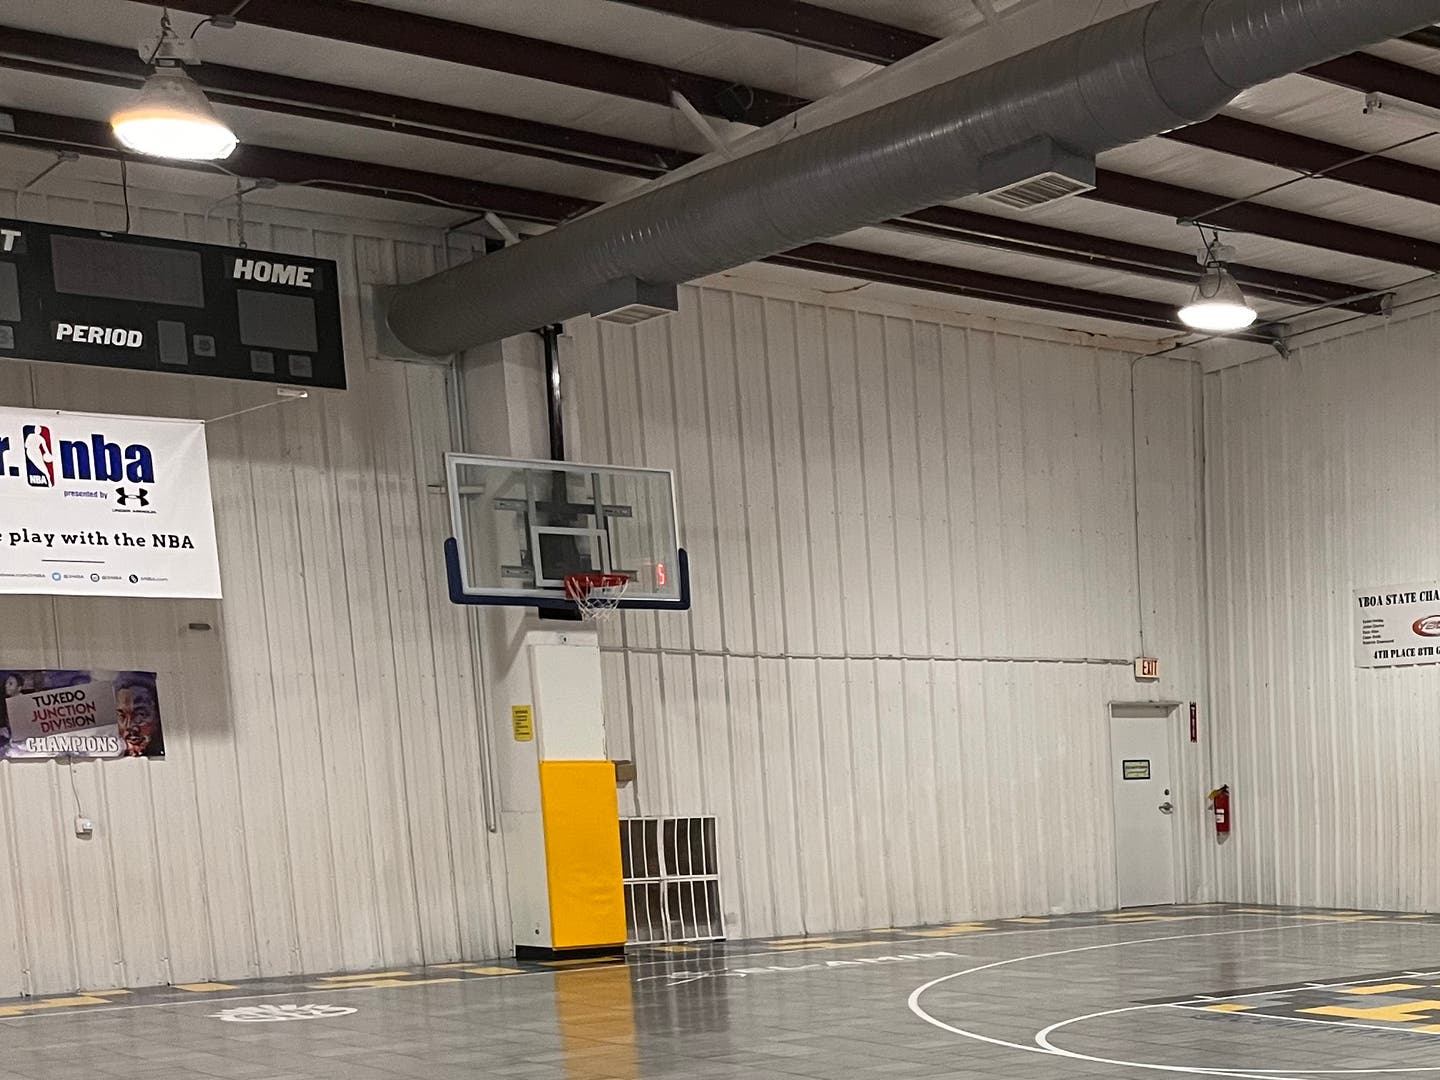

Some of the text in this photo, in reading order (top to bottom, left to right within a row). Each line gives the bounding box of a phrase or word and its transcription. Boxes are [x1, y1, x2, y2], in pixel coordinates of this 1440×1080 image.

[233, 258, 314, 288] HOME
[56, 323, 143, 348] PERIOD
[59, 434, 155, 484] nba
[29, 475, 48, 485] NBA
[64, 490, 108, 500] presented by
[9, 528, 55, 547] play
[61, 531, 109, 546] with
[114, 533, 146, 547] the
[152, 534, 195, 549] NBA
[1358, 595, 1383, 608] YBOA
[1385, 592, 1417, 605] STATE
[1374, 649, 1389, 660] 4TH
[1390, 646, 1416, 659] PLACE
[1142, 660, 1158, 676] EXIT
[32, 689, 86, 708] TUXEDO
[31, 701, 97, 723] JUNCTION
[40, 714, 96, 733] DIVISION
[25, 736, 119, 753] CHAMPIONS
